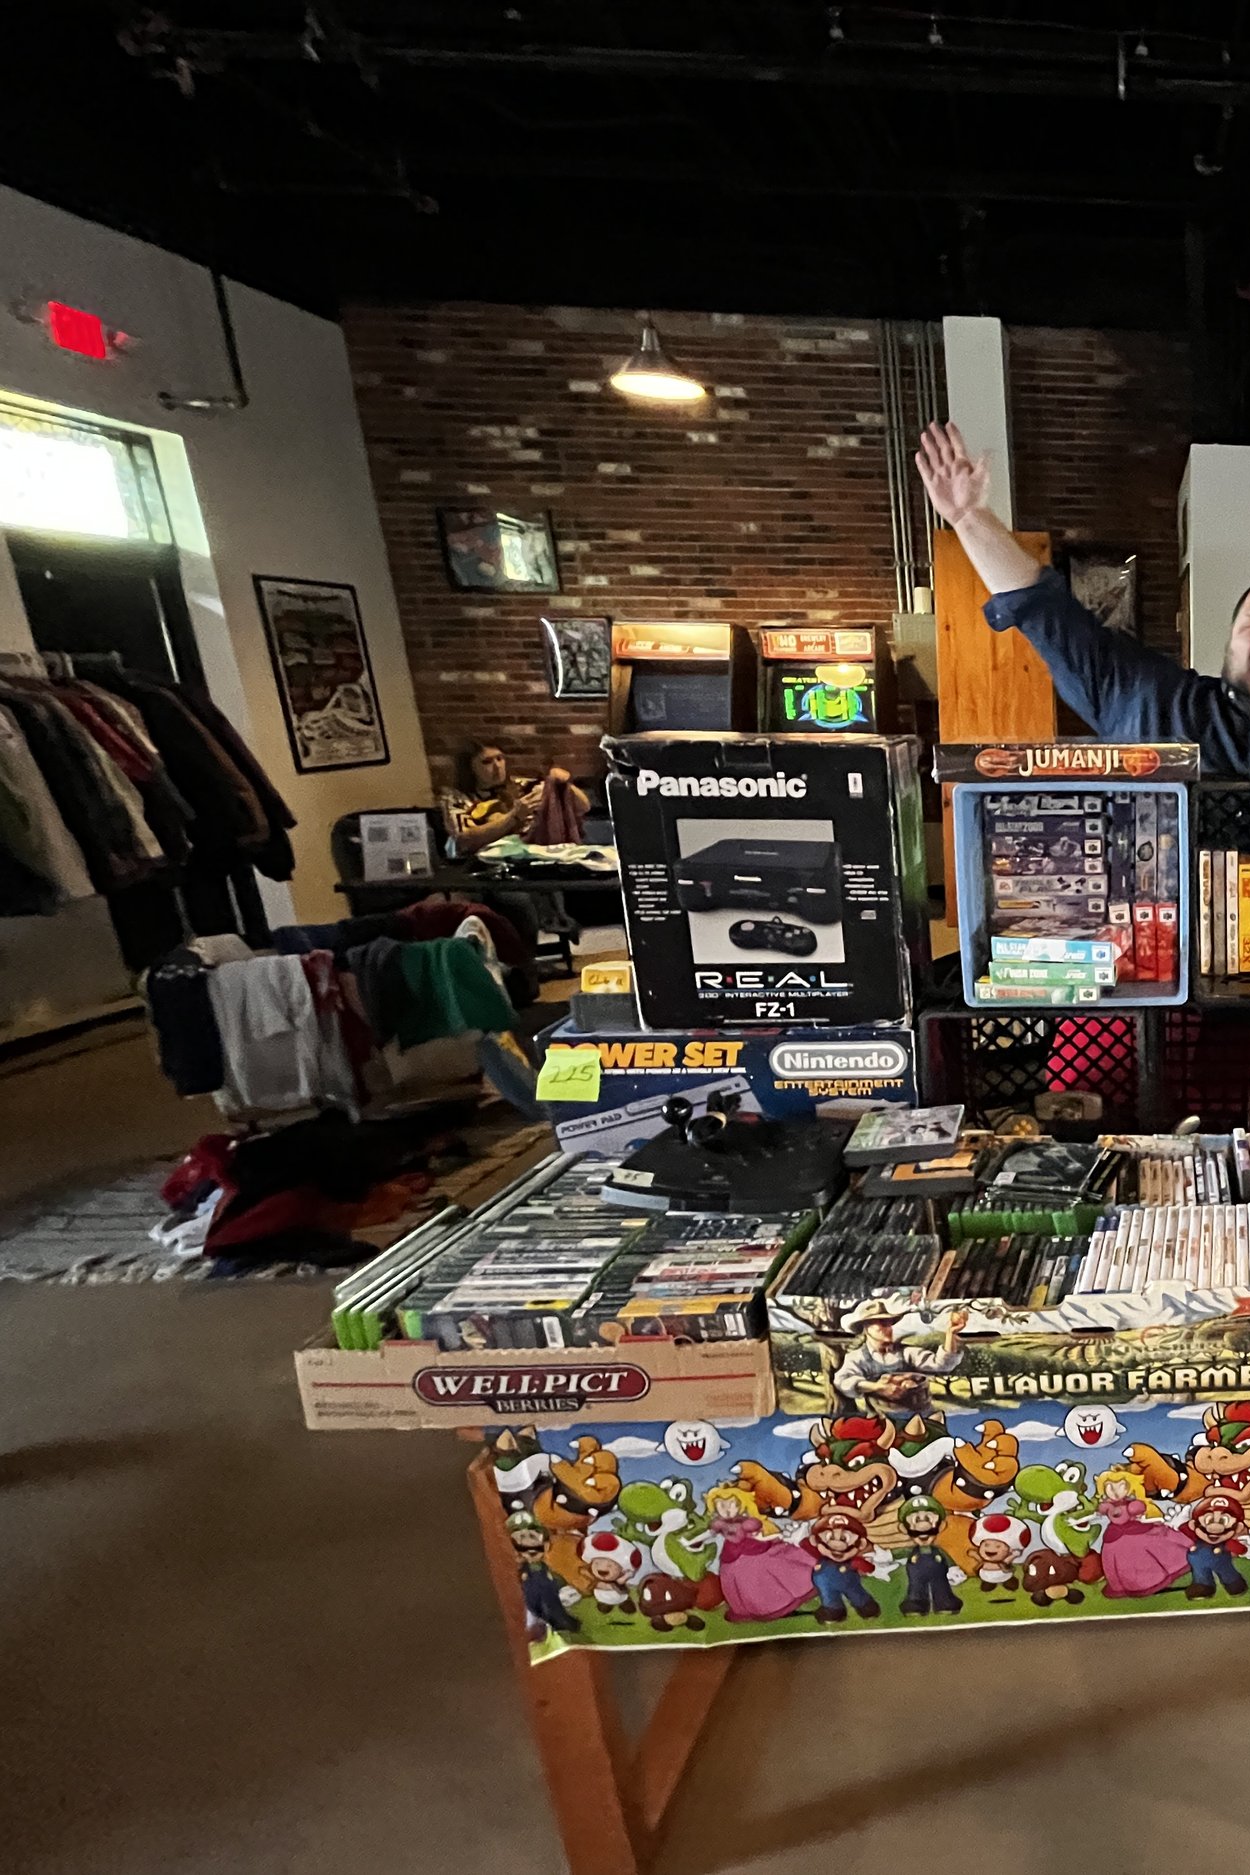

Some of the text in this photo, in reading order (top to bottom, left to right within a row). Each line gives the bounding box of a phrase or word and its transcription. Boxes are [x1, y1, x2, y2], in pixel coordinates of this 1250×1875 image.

[1019, 749, 1121, 777] JUMANJI
[636, 769, 807, 799] Panasonic
[755, 1002, 795, 1018] FZ-1
[682, 1041, 745, 1067] SET
[784, 1052, 895, 1071] Nintendo
[773, 1078, 905, 1091] ENTERTAINMENT
[808, 1087, 872, 1097] SYSTEM
[495, 1398, 580, 1412] BERRIES
